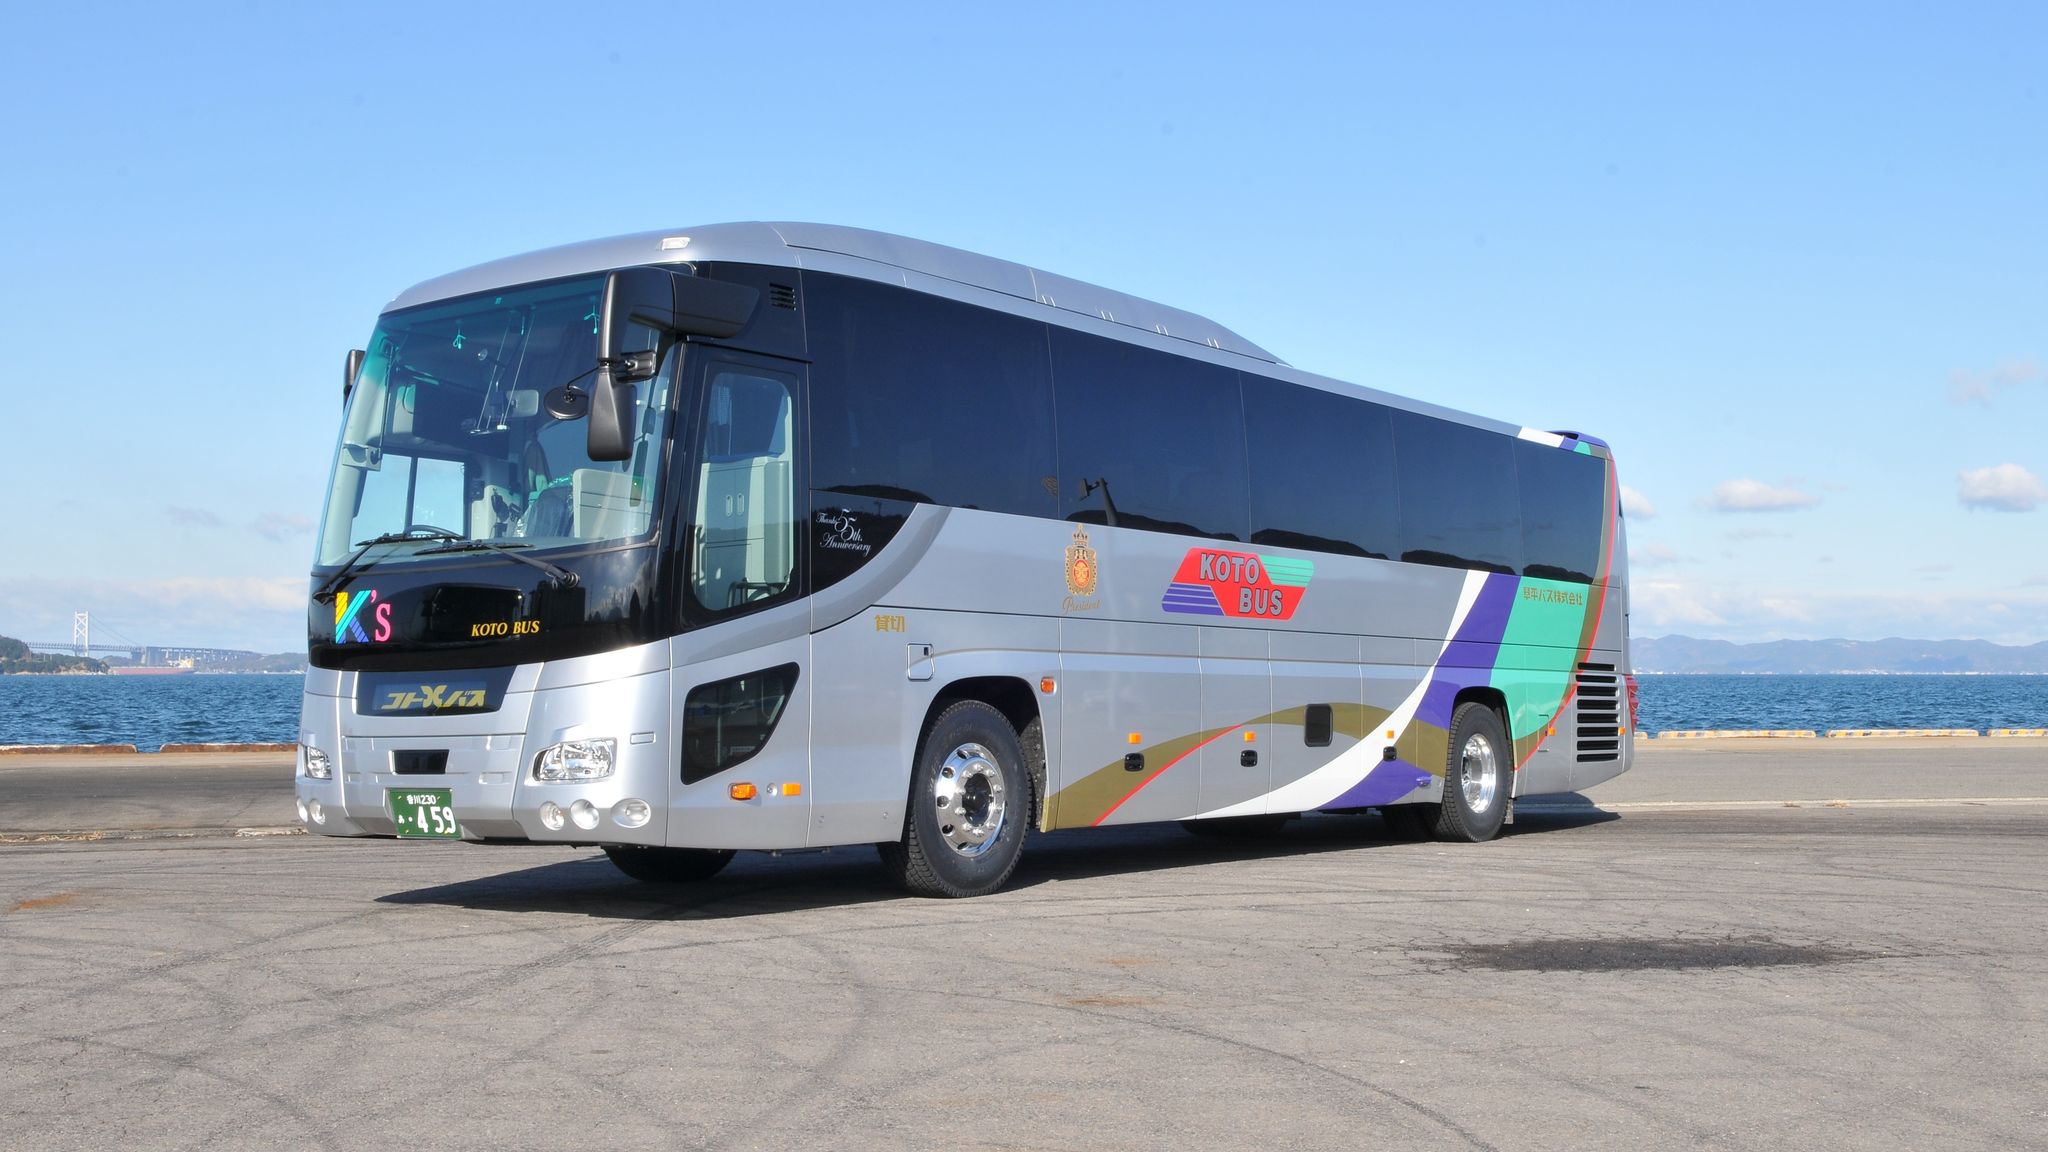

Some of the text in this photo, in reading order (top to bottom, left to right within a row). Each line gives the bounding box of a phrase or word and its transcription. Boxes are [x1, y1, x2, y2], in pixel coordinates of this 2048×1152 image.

[820, 532, 871, 557] Anniversary
[1200, 552, 1260, 585] KOTO
[1062, 596, 1102, 615] President
[1238, 586, 1283, 616] BUS
[335, 589, 392, 644] K's
[471, 620, 540, 637] KOTO BUS
[875, 614, 905, 633] 貸切
